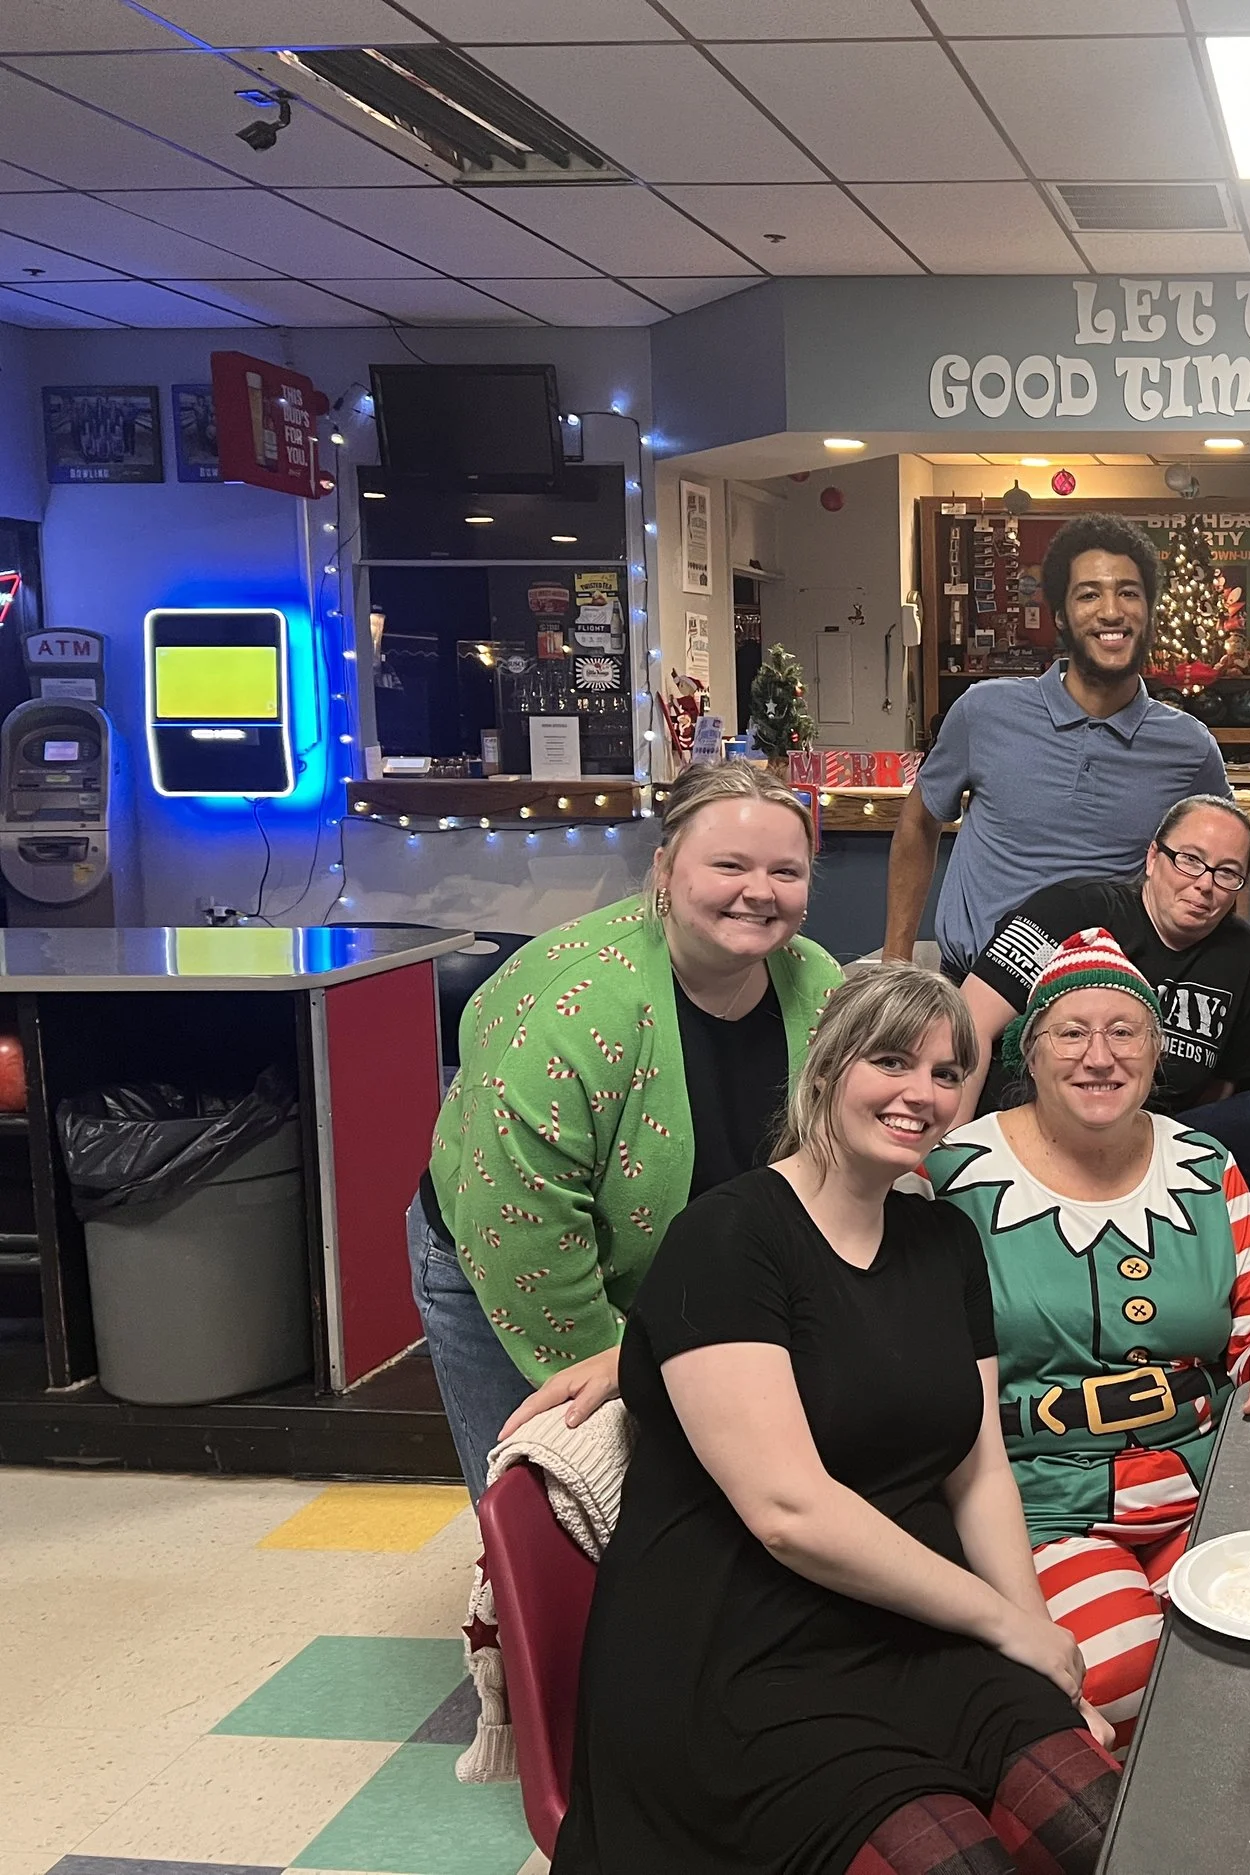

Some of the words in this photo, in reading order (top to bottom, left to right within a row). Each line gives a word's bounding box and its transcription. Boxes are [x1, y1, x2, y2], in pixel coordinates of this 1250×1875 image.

[1072, 279, 1216, 346] LET
[281, 384, 303, 407] THIS
[928, 354, 1097, 419] GOOD
[284, 425, 303, 445] FOR
[1169, 532, 1244, 546] PRTY
[38, 640, 91, 656] ATM
[786, 750, 925, 787] MERRY
[1160, 1034, 1203, 1063] NEEDS
[1205, 1048, 1217, 1069] YO
